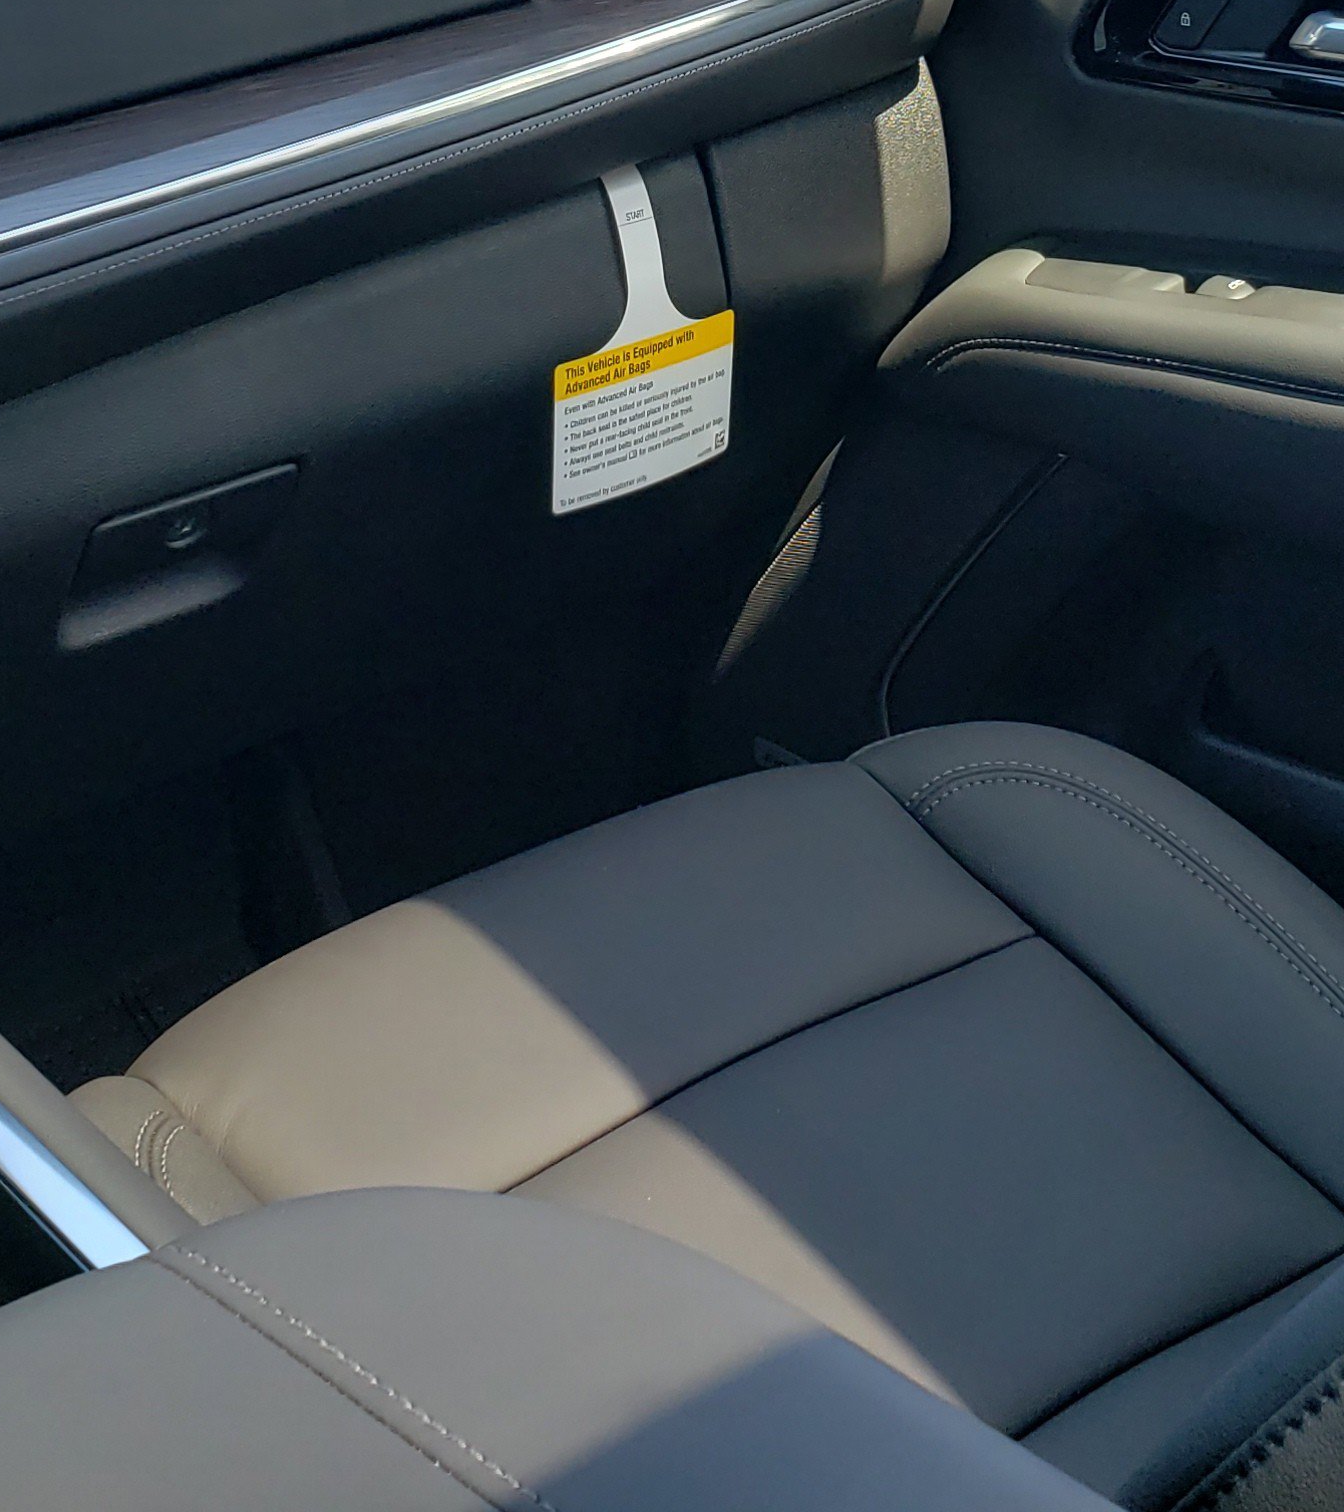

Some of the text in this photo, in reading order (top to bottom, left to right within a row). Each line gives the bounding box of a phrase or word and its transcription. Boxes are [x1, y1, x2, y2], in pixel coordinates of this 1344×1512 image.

[625, 208, 645, 222] START
[565, 366, 585, 380] This
[587, 352, 620, 373] Vehicle
[633, 336, 673, 360] Equipped
[676, 329, 695, 345] with
[565, 359, 651, 395] Advanced Air Bags
[564, 380, 654, 416] Even with Advanced Air Bags
